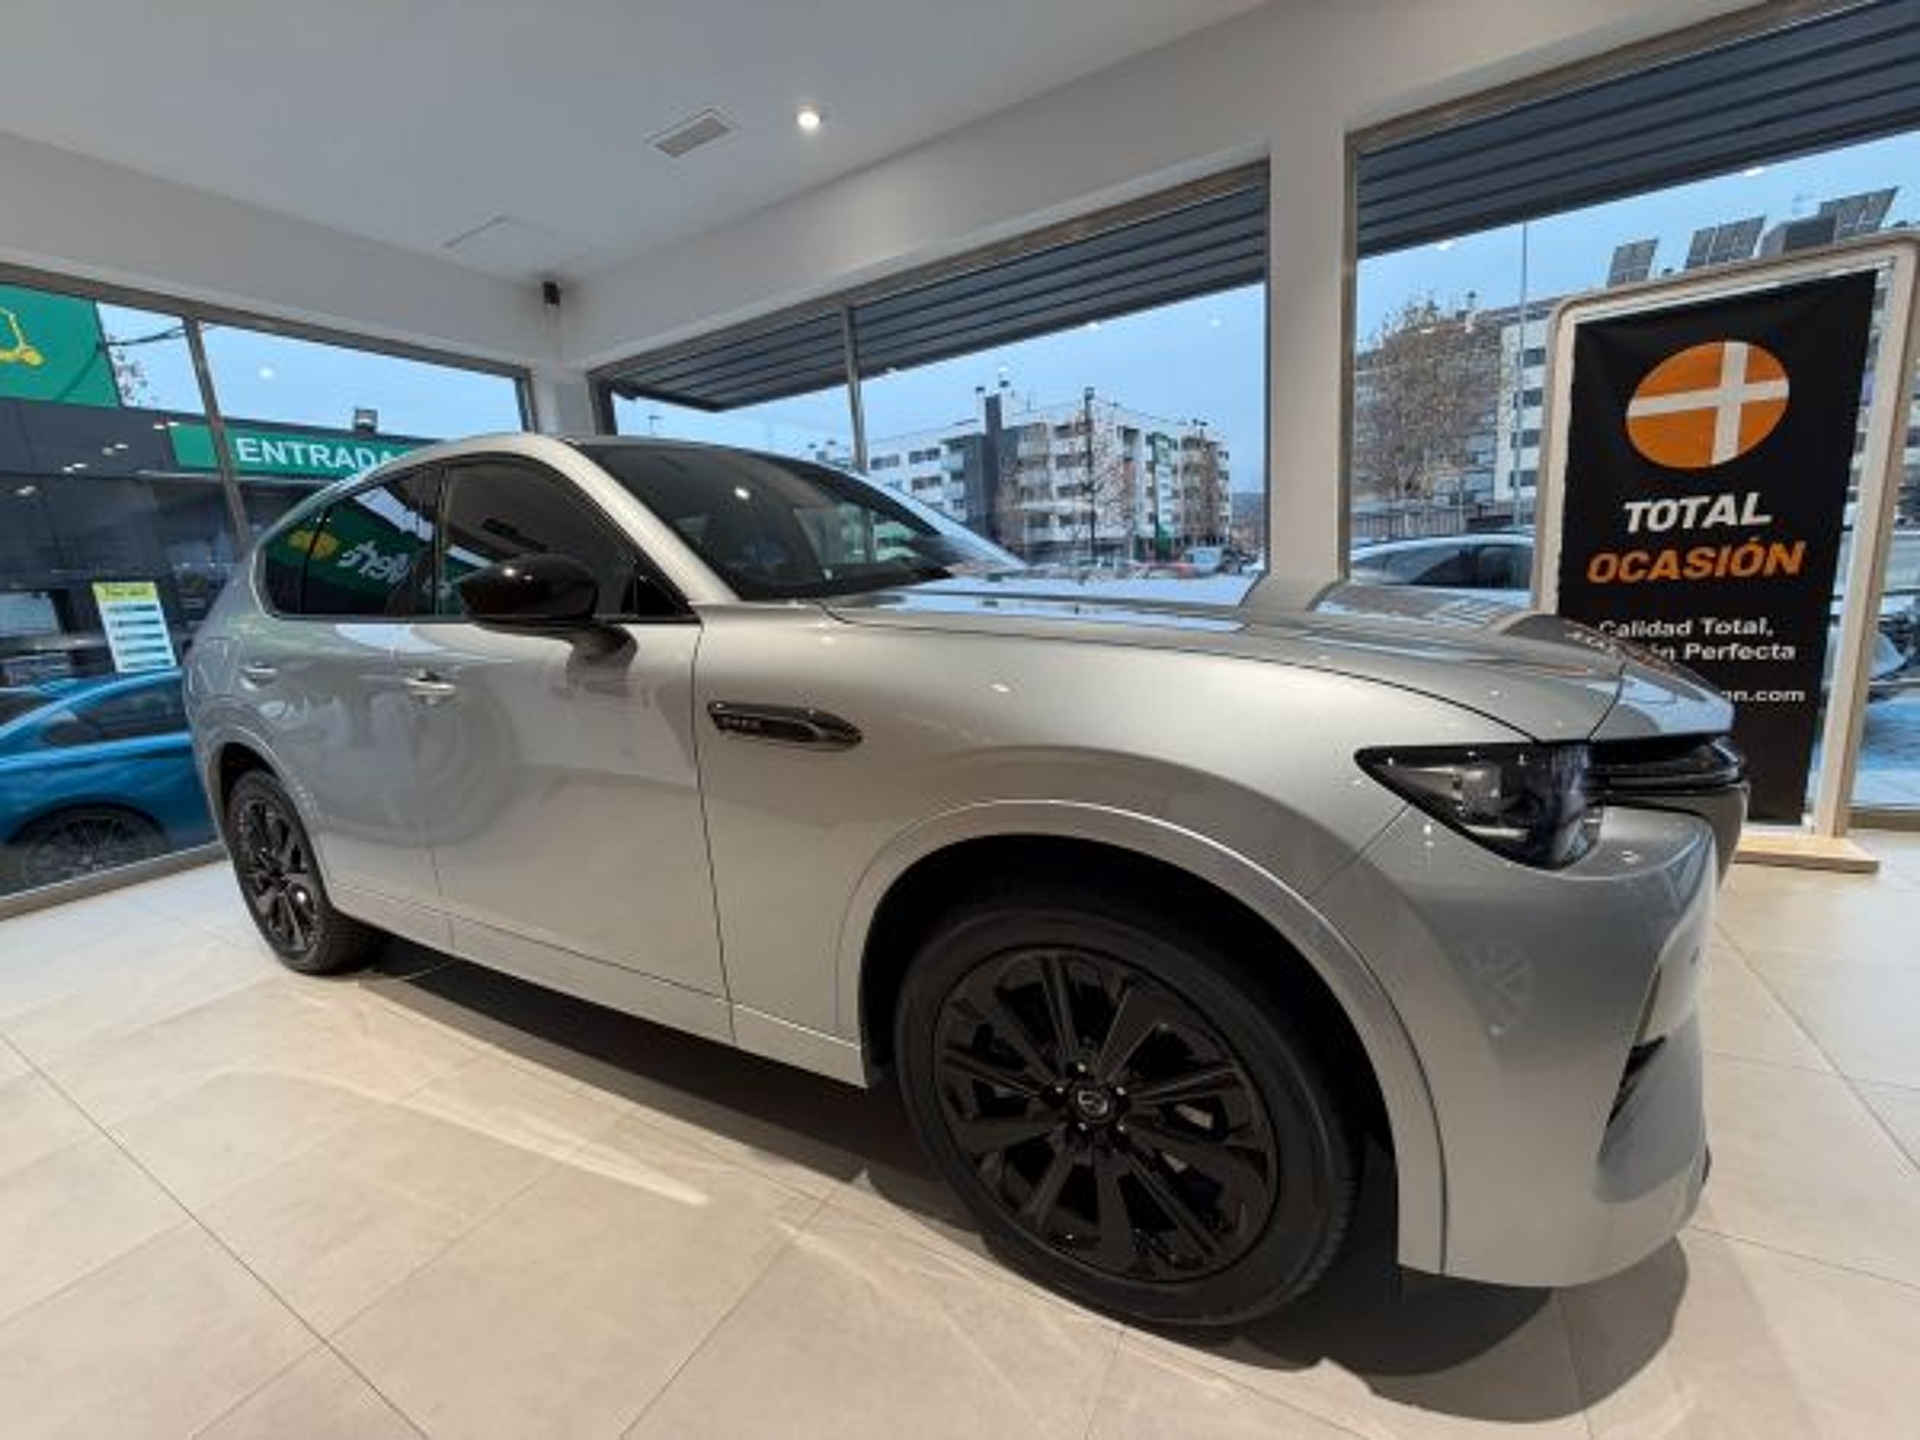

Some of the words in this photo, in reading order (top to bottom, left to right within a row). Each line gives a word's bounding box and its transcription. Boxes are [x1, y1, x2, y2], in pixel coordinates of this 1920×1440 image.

[1624, 492, 1773, 534] TOTAL
[1586, 536, 1807, 583] OCASIÓN
[1599, 619, 1693, 638] Calidad
[1701, 616, 1774, 637] Total,
[1684, 642, 1796, 660] Perfecta
